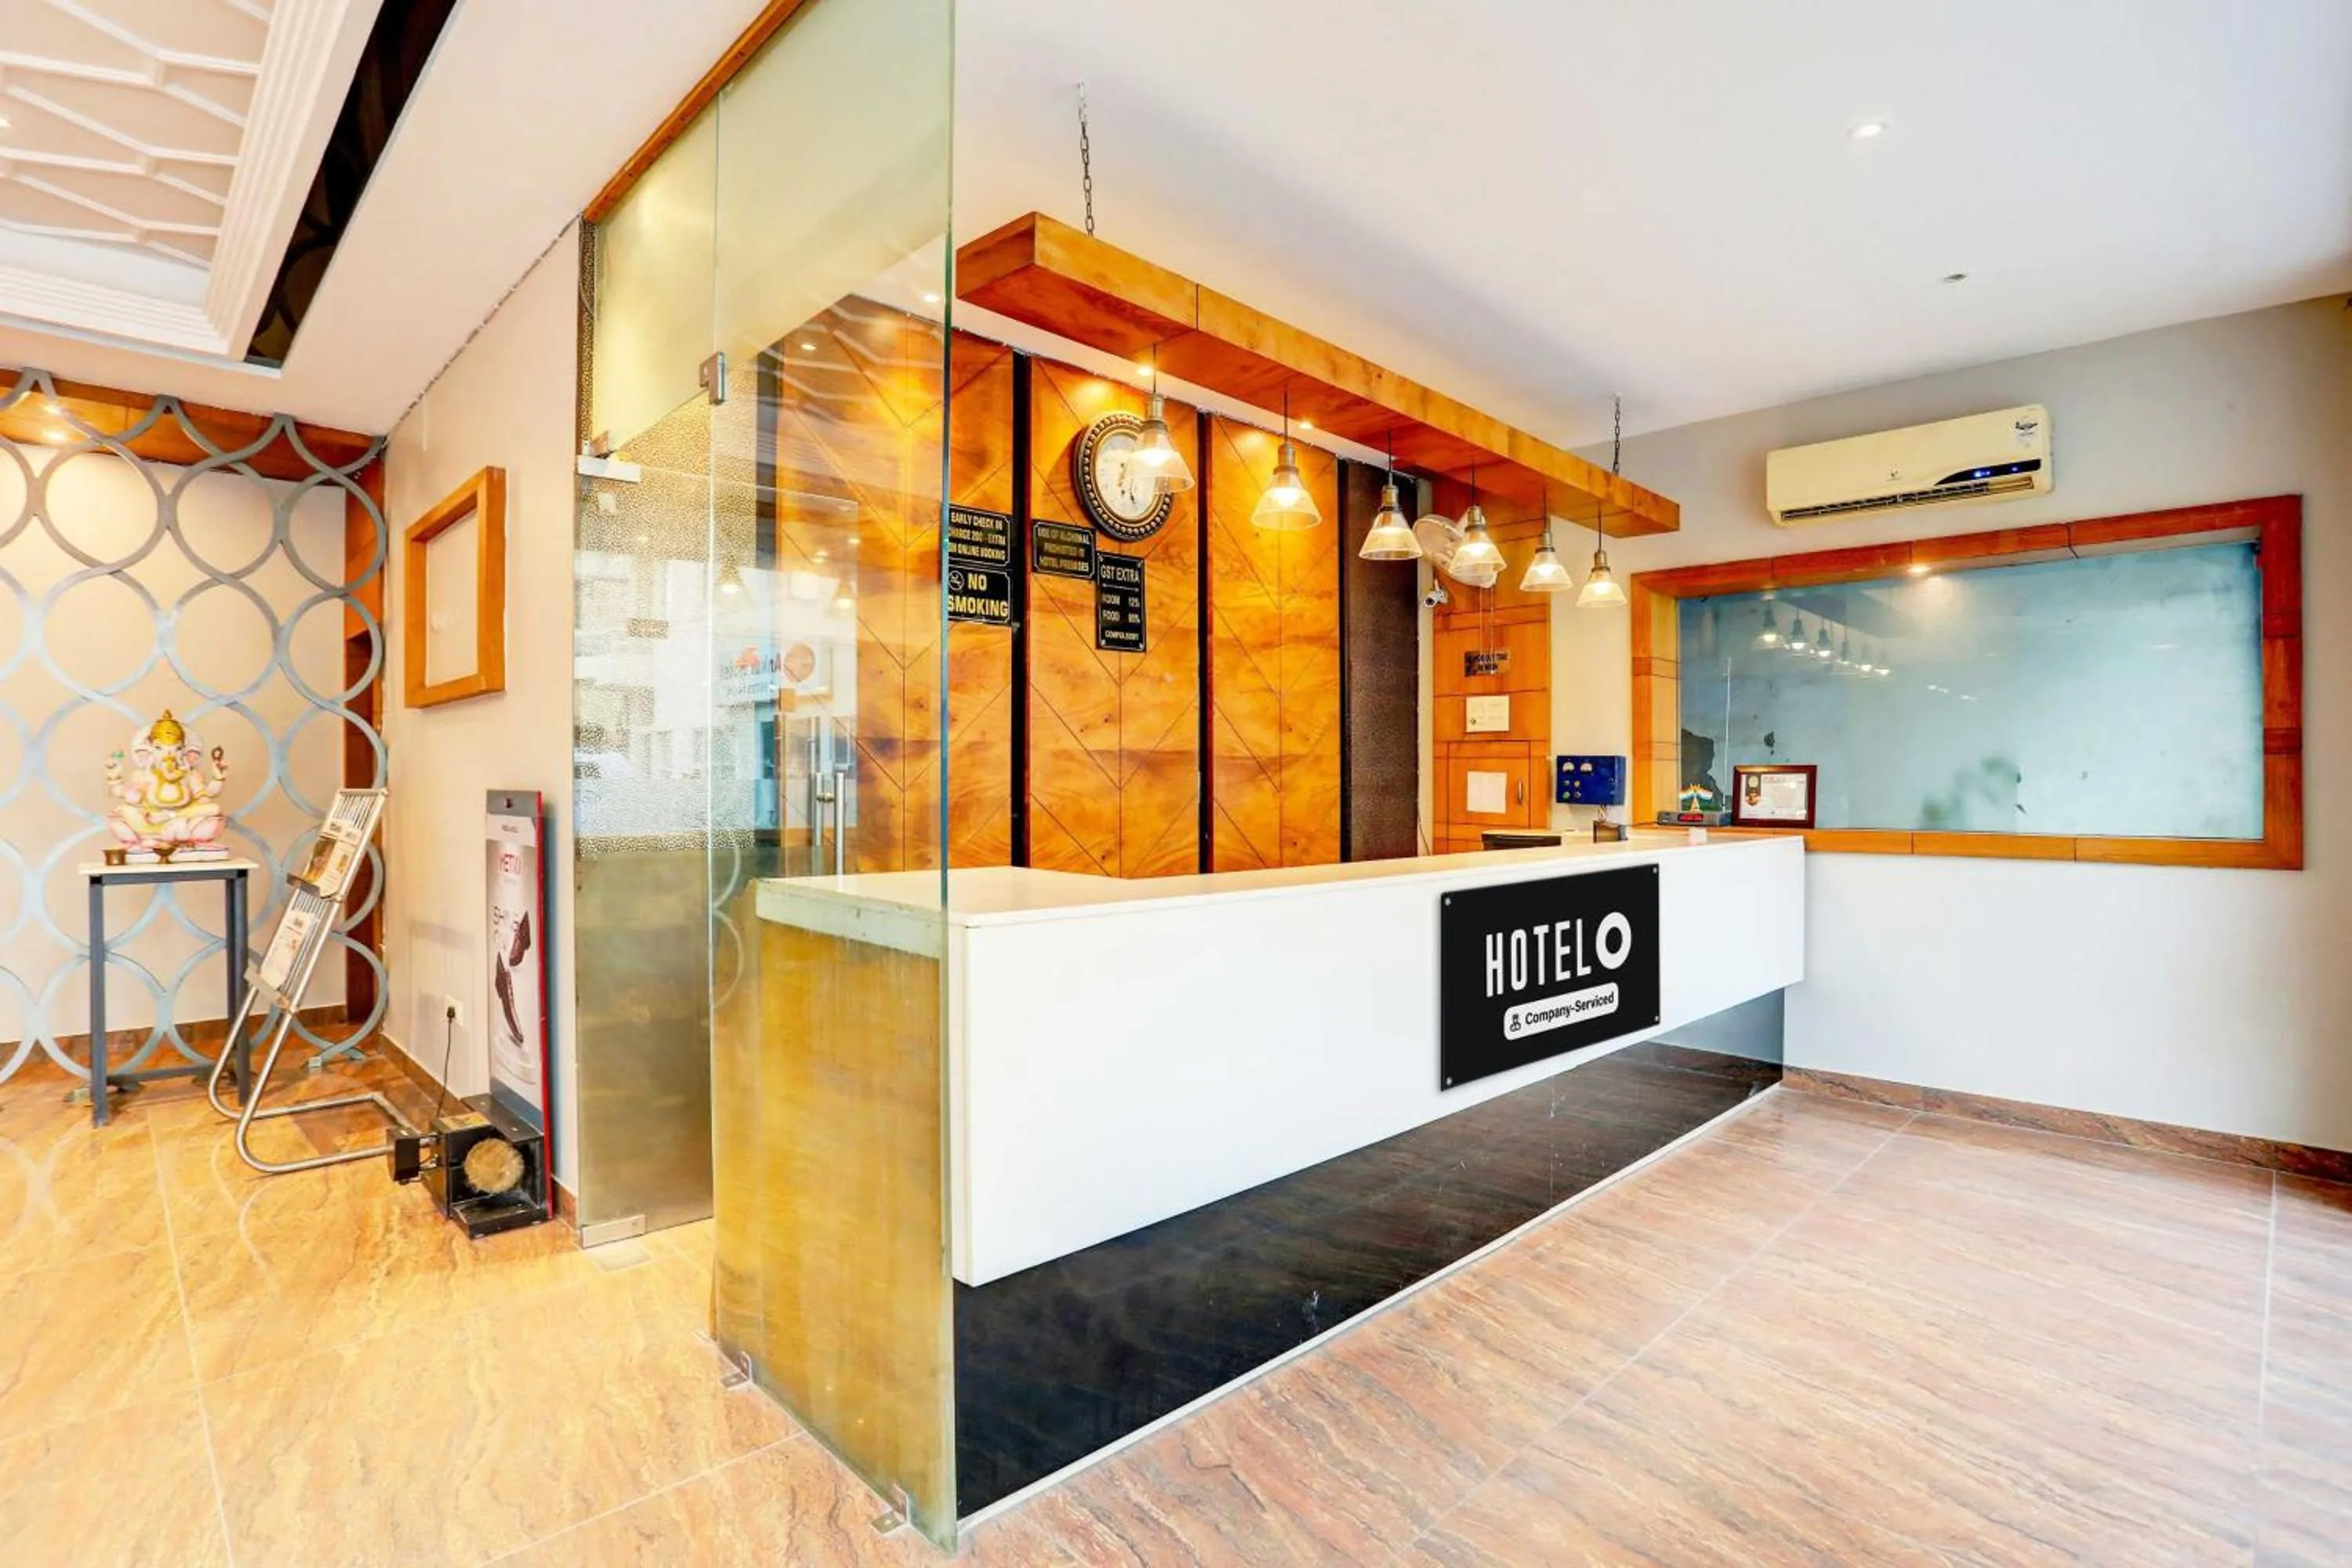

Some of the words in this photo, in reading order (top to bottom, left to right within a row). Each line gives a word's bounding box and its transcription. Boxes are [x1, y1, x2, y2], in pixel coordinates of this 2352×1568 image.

[951, 512, 972, 525] EARLY
[973, 516, 994, 529] CHECK
[958, 543, 979, 557] ONLINE
[980, 547, 1005, 561] BOOKING
[967, 572, 987, 591] NO
[1100, 564, 1115, 579] GST
[1116, 567, 1140, 583] EXTRA
[948, 594, 1008, 617] SMOKING
[1102, 593, 1120, 605] ROOM
[1102, 609, 1120, 622] FOOD
[1486, 918, 1592, 997] HOTEL
[1525, 990, 1614, 1023] Company-Serviced
